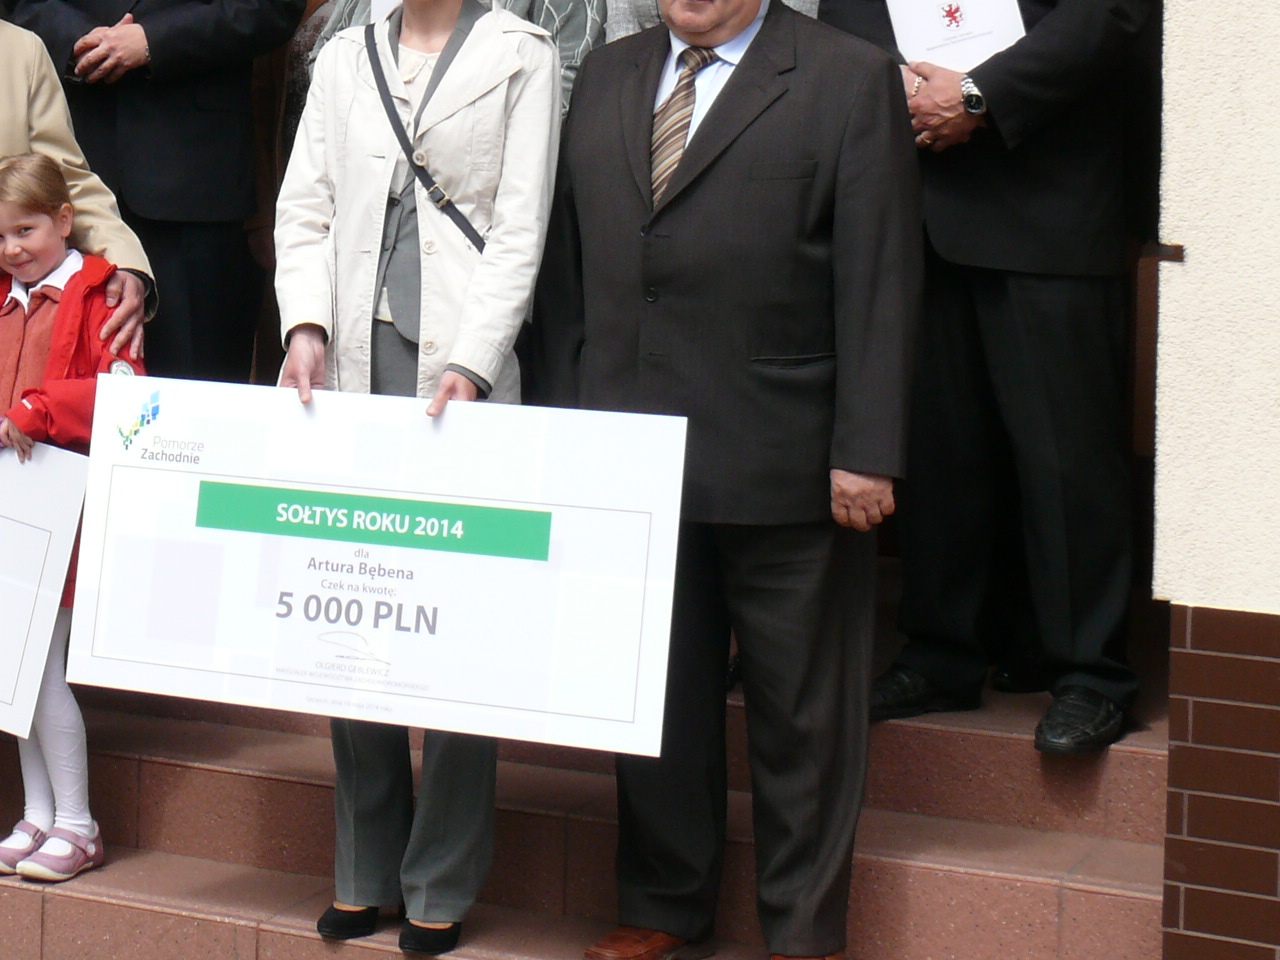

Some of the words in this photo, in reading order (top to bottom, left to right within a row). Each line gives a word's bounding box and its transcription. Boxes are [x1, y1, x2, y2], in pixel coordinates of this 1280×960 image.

[153, 436, 204, 452] Pomorze
[140, 448, 200, 464] Zachodnie
[276, 503, 348, 528] SOŁTYS
[352, 510, 410, 534] ROKU
[414, 517, 464, 539] 2014
[354, 548, 370, 559] dla
[307, 557, 354, 574] Artura
[358, 562, 414, 580] Bębena
[321, 579, 344, 591] Czek
[348, 582, 360, 592] na
[276, 591, 294, 618] 5
[303, 594, 364, 626] 000
[373, 600, 438, 635] PLN
